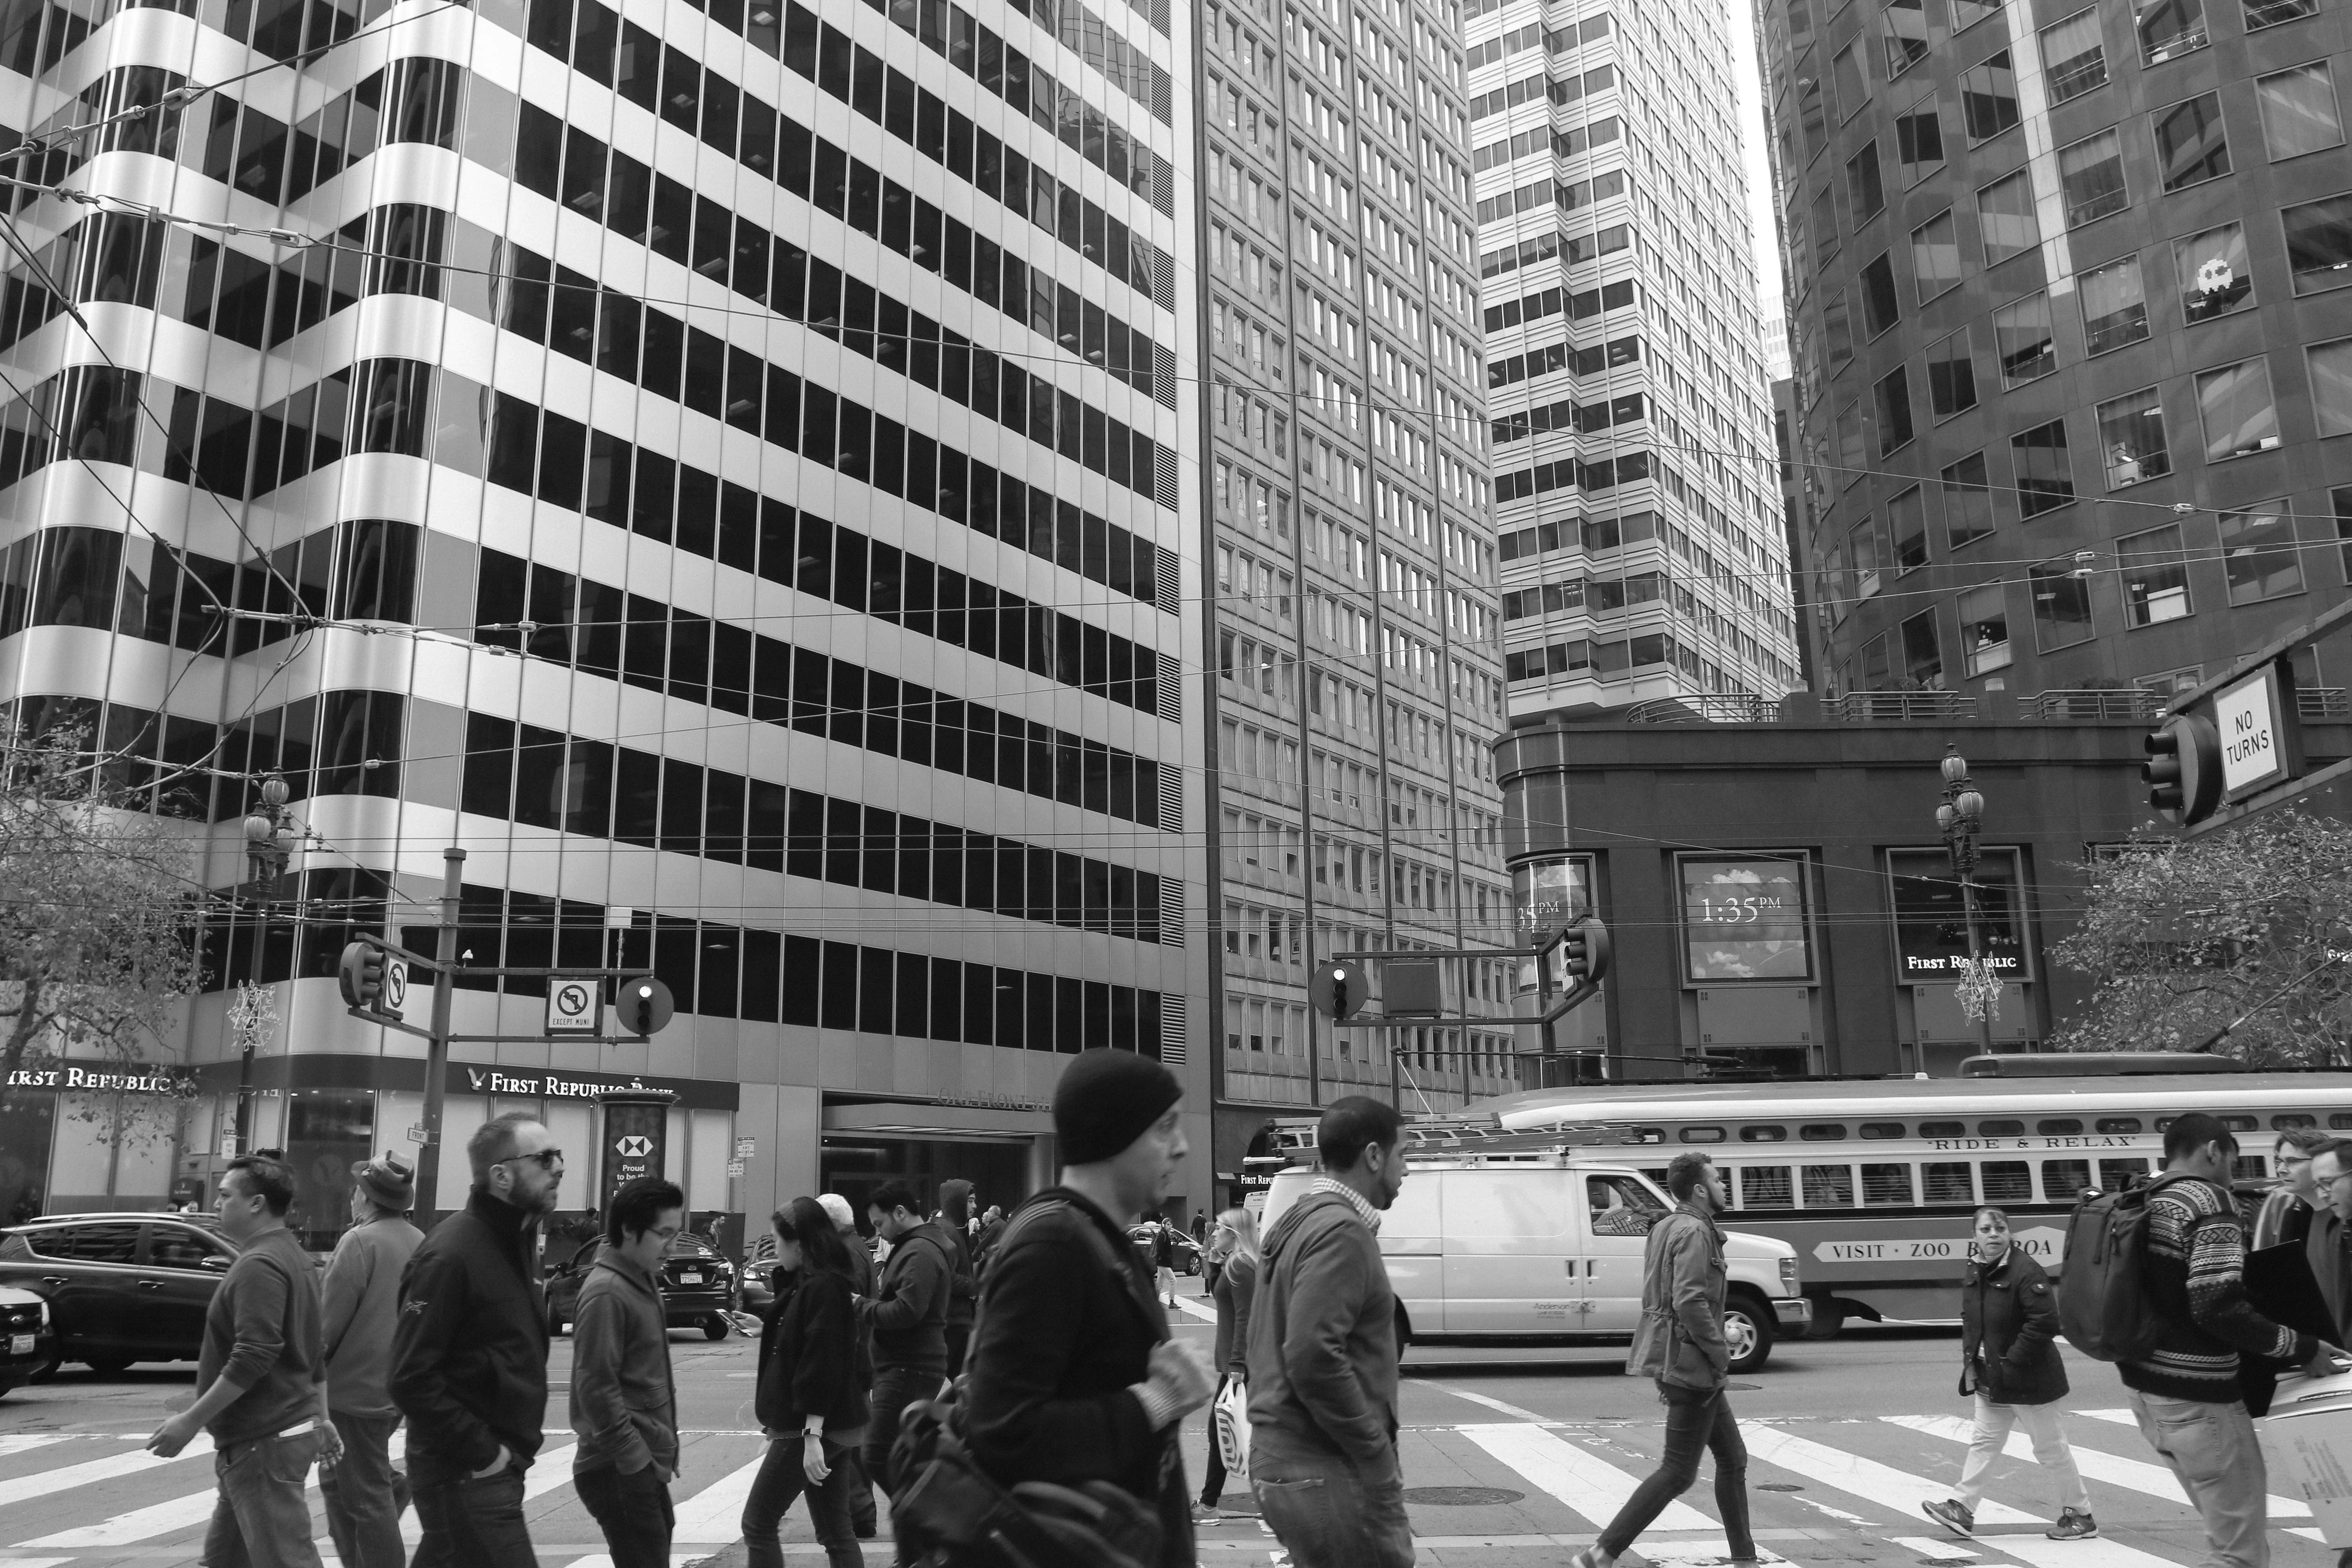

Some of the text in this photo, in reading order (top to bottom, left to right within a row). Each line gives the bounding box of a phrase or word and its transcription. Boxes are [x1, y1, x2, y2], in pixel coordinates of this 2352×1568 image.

[2236, 710, 2252, 735] NO
[2227, 730, 2269, 765] TURNS
[1907, 955, 2017, 969] FIRST REUBLIC
[6, 1070, 59, 1087] IRST
[490, 1073, 539, 1094] FIRST
[2017, 1139, 2029, 1148] &
[1241, 1174, 1274, 1184] FIRST REPU
[1832, 1244, 1884, 1258] VISIT
[1910, 1243, 1950, 1257] ZOO
